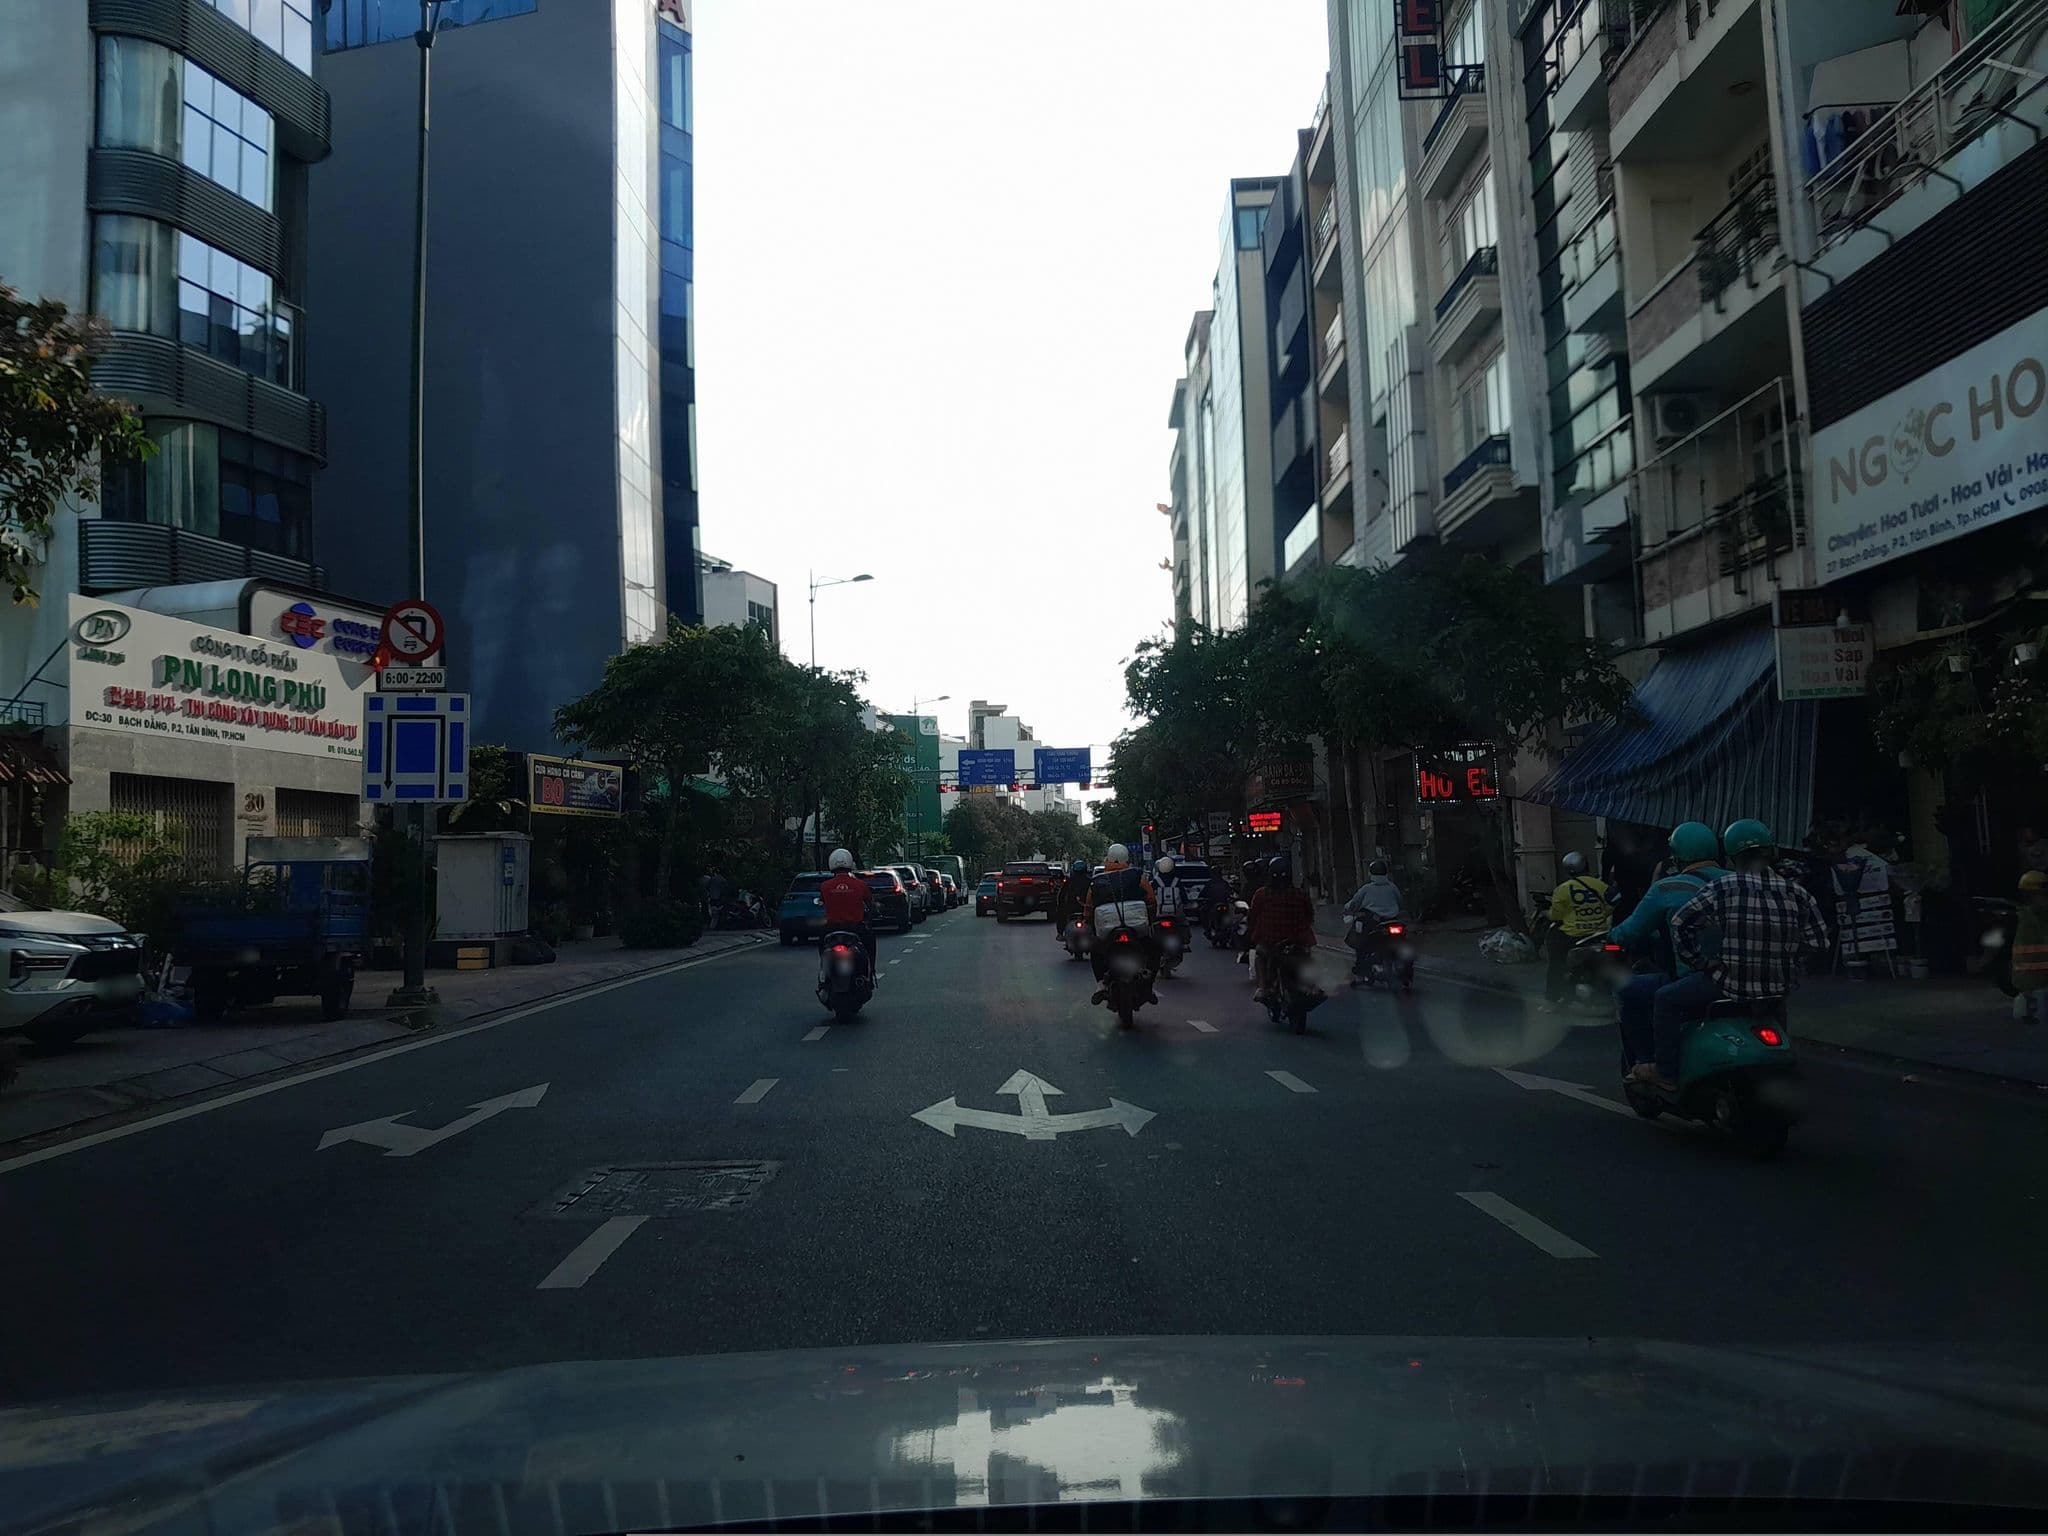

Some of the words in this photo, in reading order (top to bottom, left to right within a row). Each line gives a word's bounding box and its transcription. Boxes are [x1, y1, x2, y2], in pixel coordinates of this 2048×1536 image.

[1880, 511, 1909, 533] Hoa
[1951, 480, 1982, 505] Hoa
[195, 635, 232, 656] CÔNG
[235, 645, 248, 659] TY
[163, 654, 202, 689] PN
[210, 664, 277, 704] LONG
[283, 679, 327, 711] PHÚ
[187, 698, 205, 716] THI
[208, 700, 238, 723] CÔNG
[118, 715, 142, 729] BẠCH
[185, 724, 200, 735] TÂN
[245, 793, 265, 812] 30
